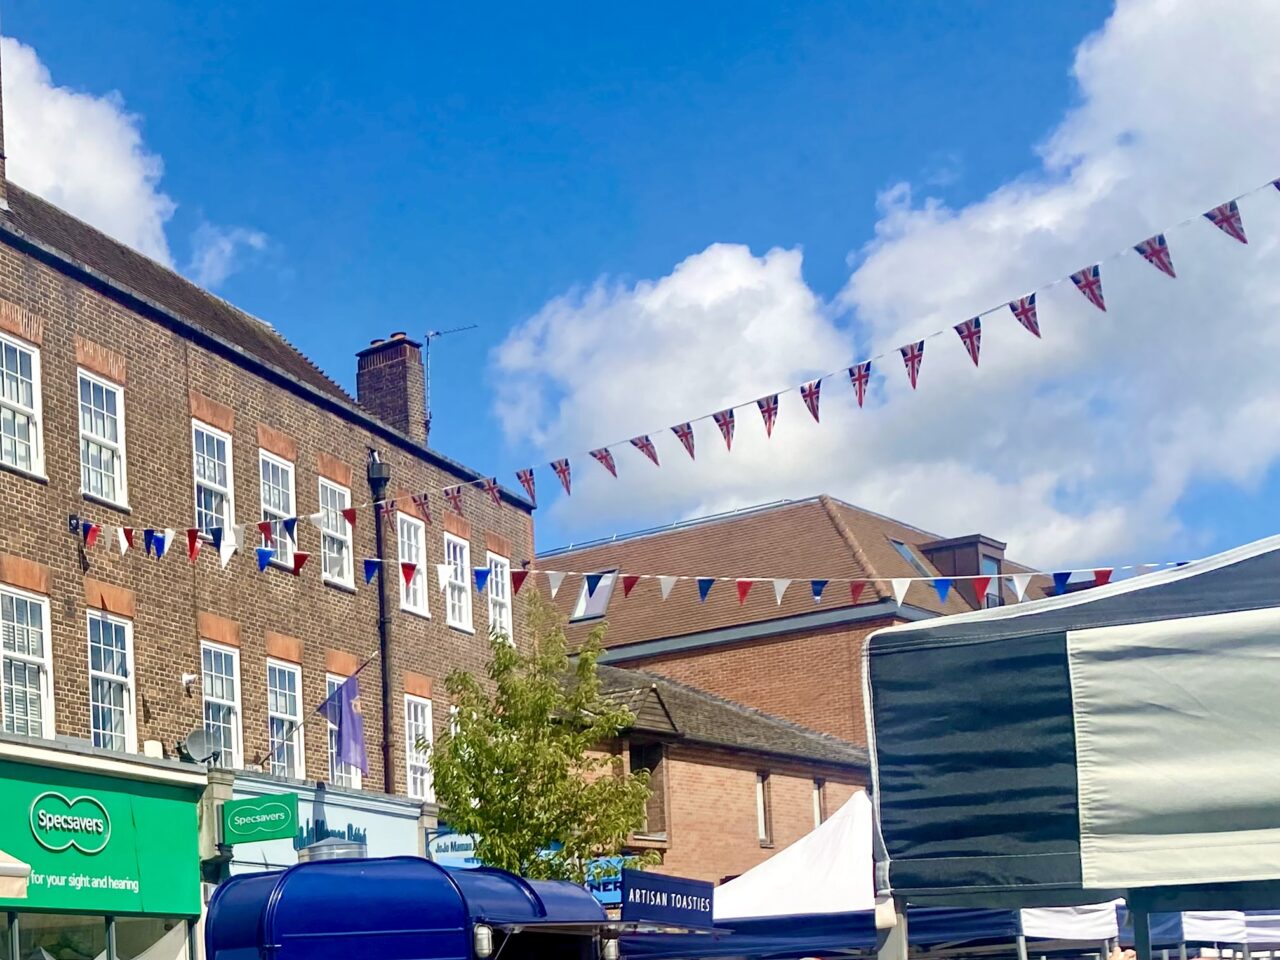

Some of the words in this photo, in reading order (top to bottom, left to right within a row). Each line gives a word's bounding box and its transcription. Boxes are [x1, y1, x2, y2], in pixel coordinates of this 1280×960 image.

[38, 808, 104, 833] Specsavers
[234, 811, 285, 826] Specsavers
[31, 869, 44, 885] for
[46, 873, 67, 888] your
[68, 872, 91, 891] sight
[91, 875, 108, 889] and
[108, 876, 140, 894] hearing
[628, 887, 668, 907] ARTISAN
[671, 893, 710, 912] TOASTIES
